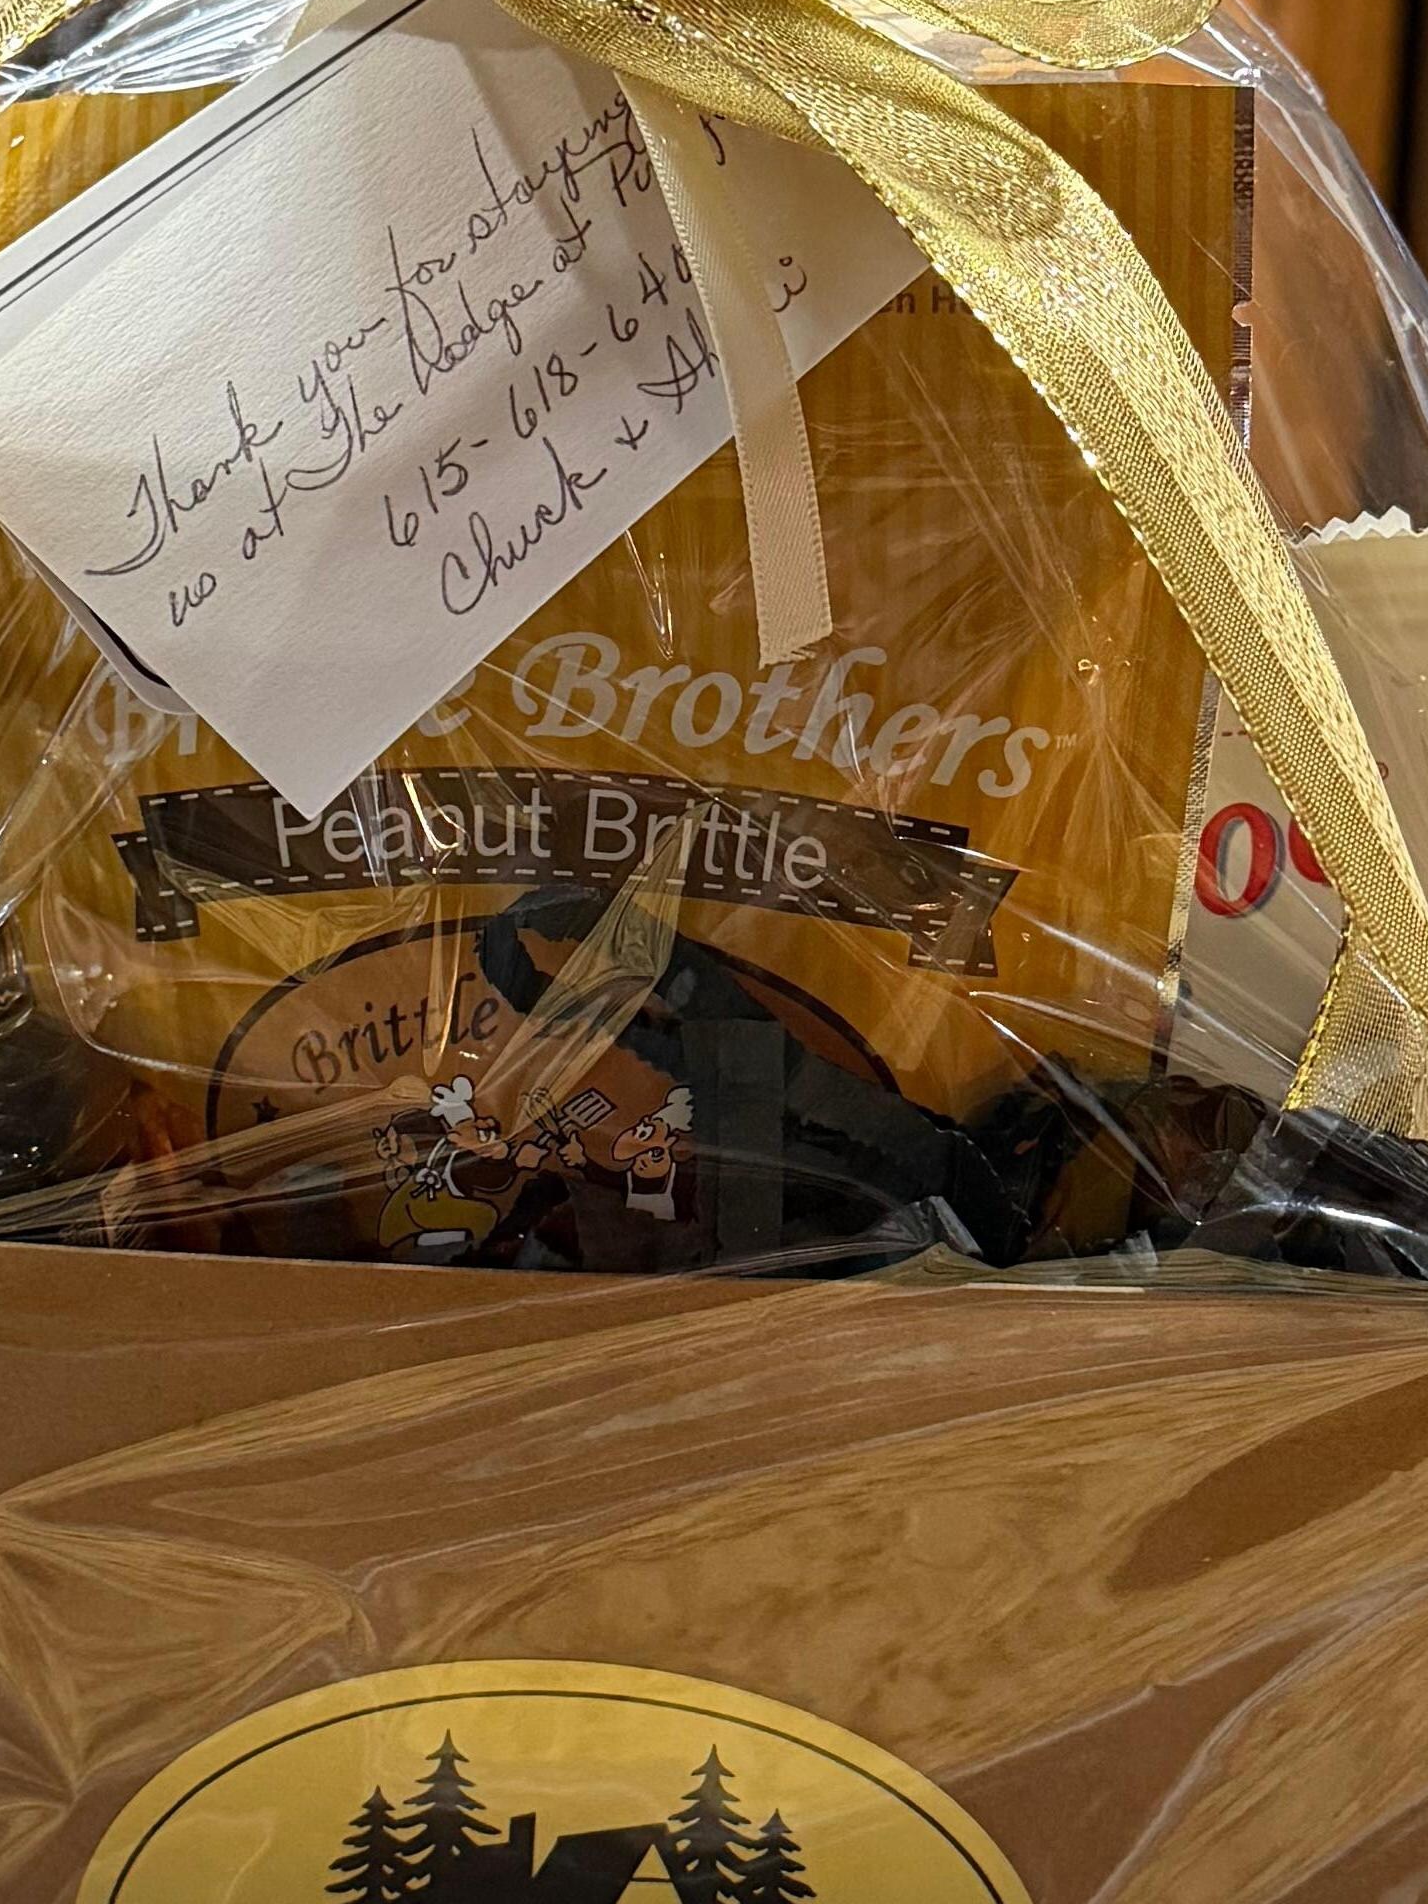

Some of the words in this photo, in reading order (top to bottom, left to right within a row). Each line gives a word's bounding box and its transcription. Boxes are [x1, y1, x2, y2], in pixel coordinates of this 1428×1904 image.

[84, 380, 284, 576] Thank
[297, 317, 388, 440] you
[470, 91, 647, 255] staying
[169, 572, 217, 627] us
[242, 457, 288, 560] at
[285, 374, 404, 491] The
[384, 279, 544, 373] Lodge
[552, 196, 592, 273] at
[441, 436, 608, 615] Chuck
[512, 631, 1050, 798] Brothers
[273, 788, 553, 869] Peanut
[582, 787, 828, 890] Brittle
[291, 971, 502, 1094] Brittle
